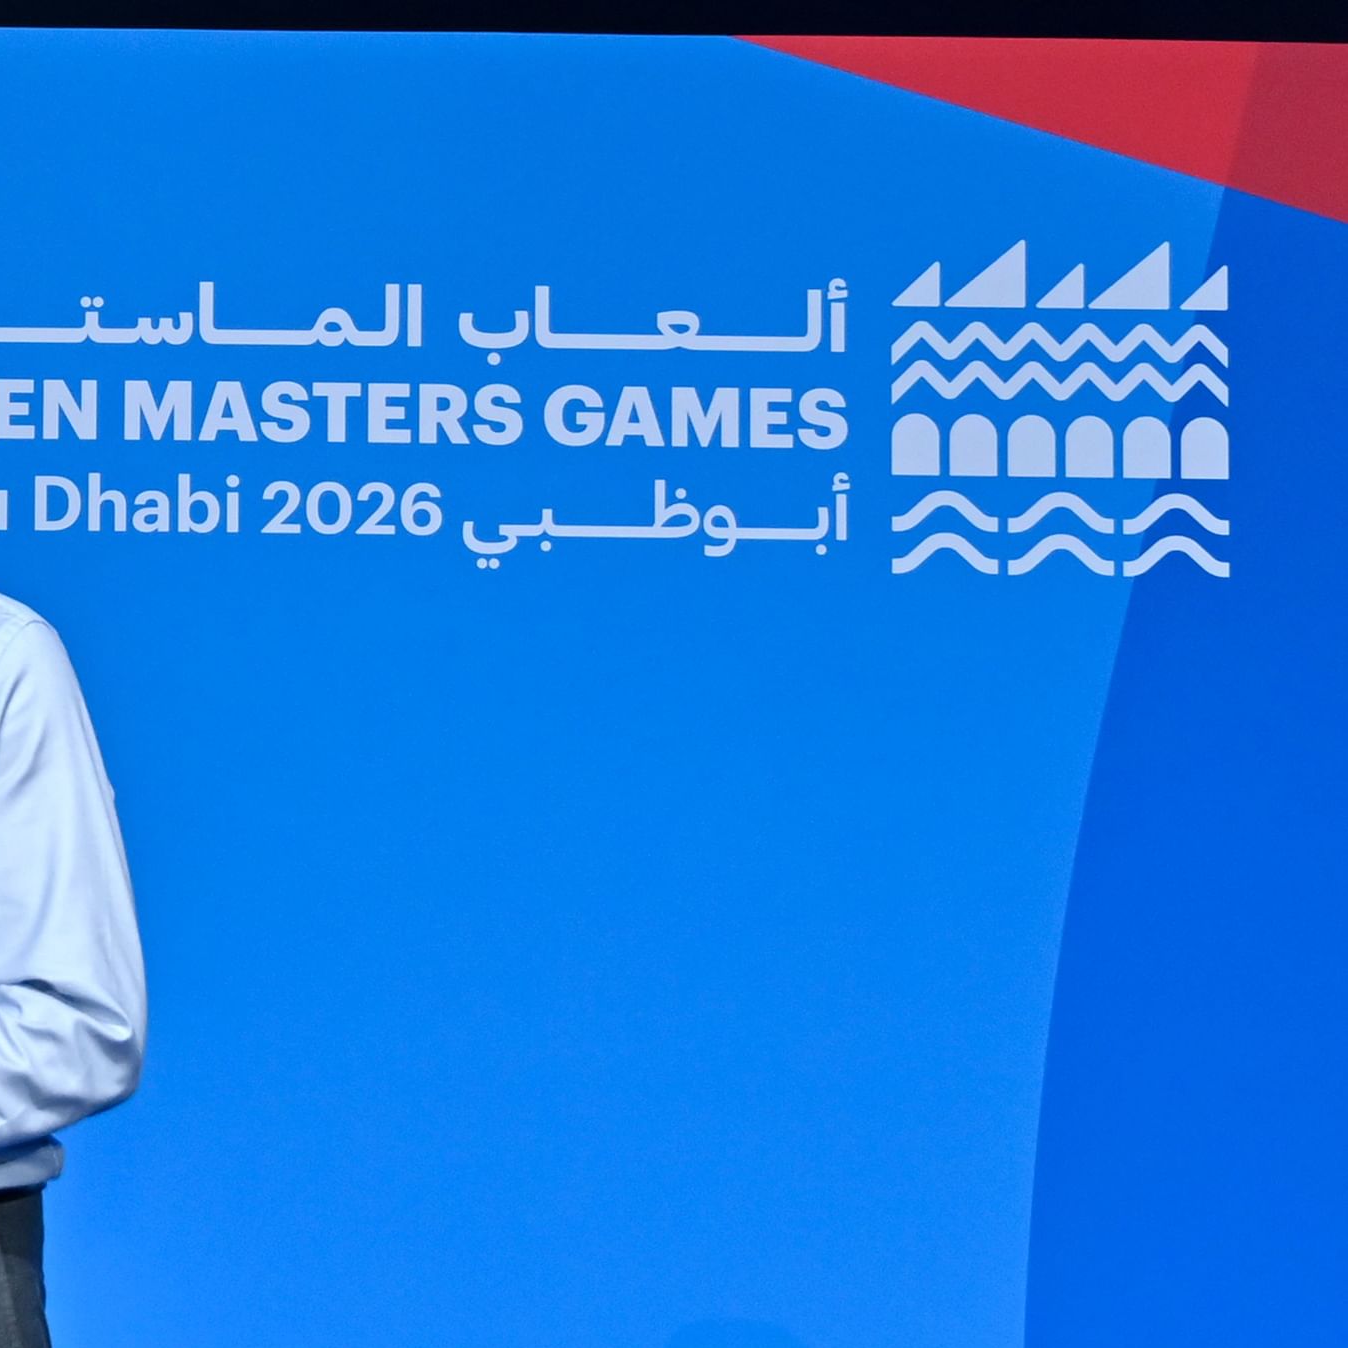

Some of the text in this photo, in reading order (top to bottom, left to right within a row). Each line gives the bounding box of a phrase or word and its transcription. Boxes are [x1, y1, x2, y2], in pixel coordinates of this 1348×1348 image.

[459, 278, 848, 366] ألعاب
[123, 379, 523, 446] MASTERS
[543, 384, 849, 450] GAMES
[33, 472, 241, 534] Dhabi
[260, 480, 444, 536] 2026
[462, 472, 851, 569] أبوظبي
